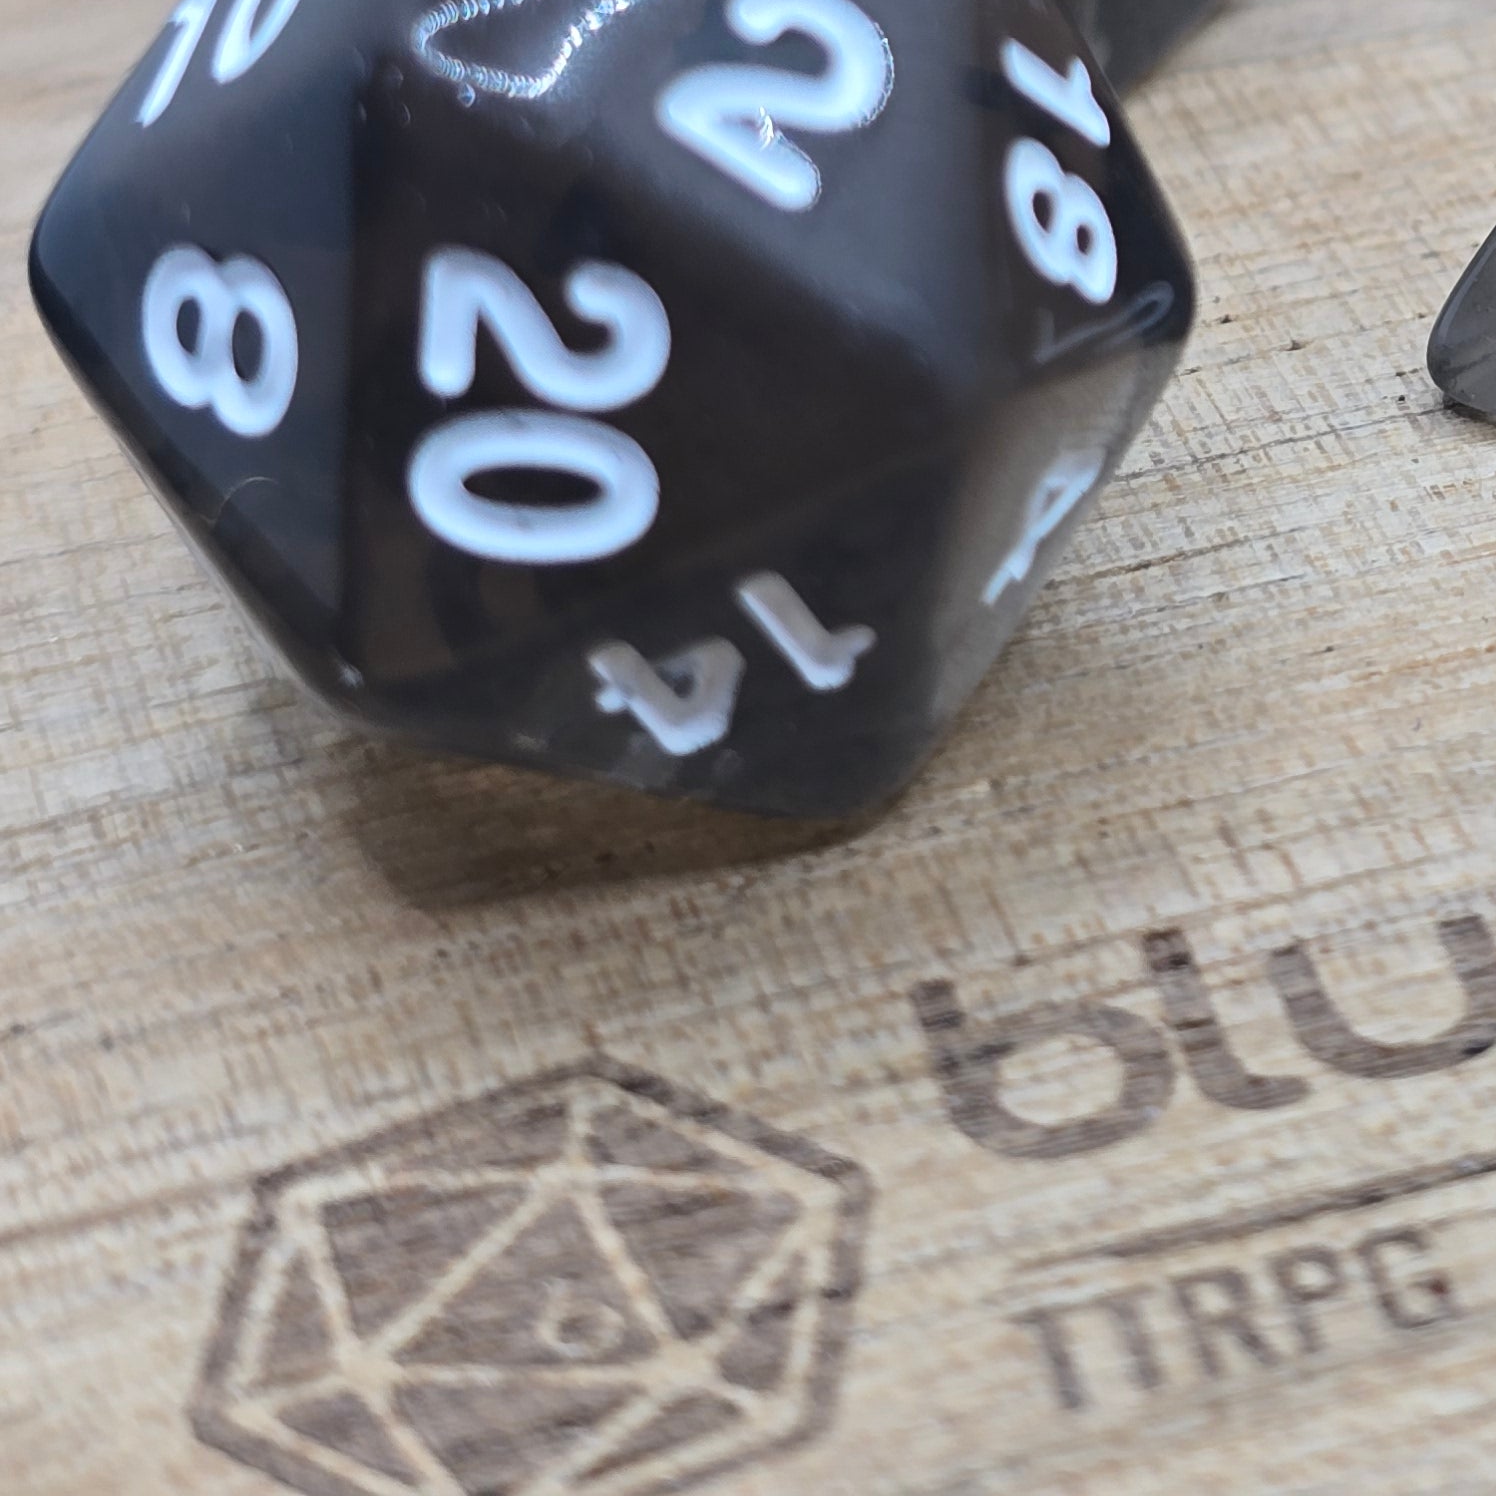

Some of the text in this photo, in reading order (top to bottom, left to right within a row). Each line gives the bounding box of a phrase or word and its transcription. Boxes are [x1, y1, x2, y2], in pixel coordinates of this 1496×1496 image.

[1002, 37, 1119, 305] 18
[141, 244, 300, 439] 8
[407, 246, 672, 566] 20
[588, 572, 878, 758] 14
[1010, 1224, 1462, 1411] TTRPG
